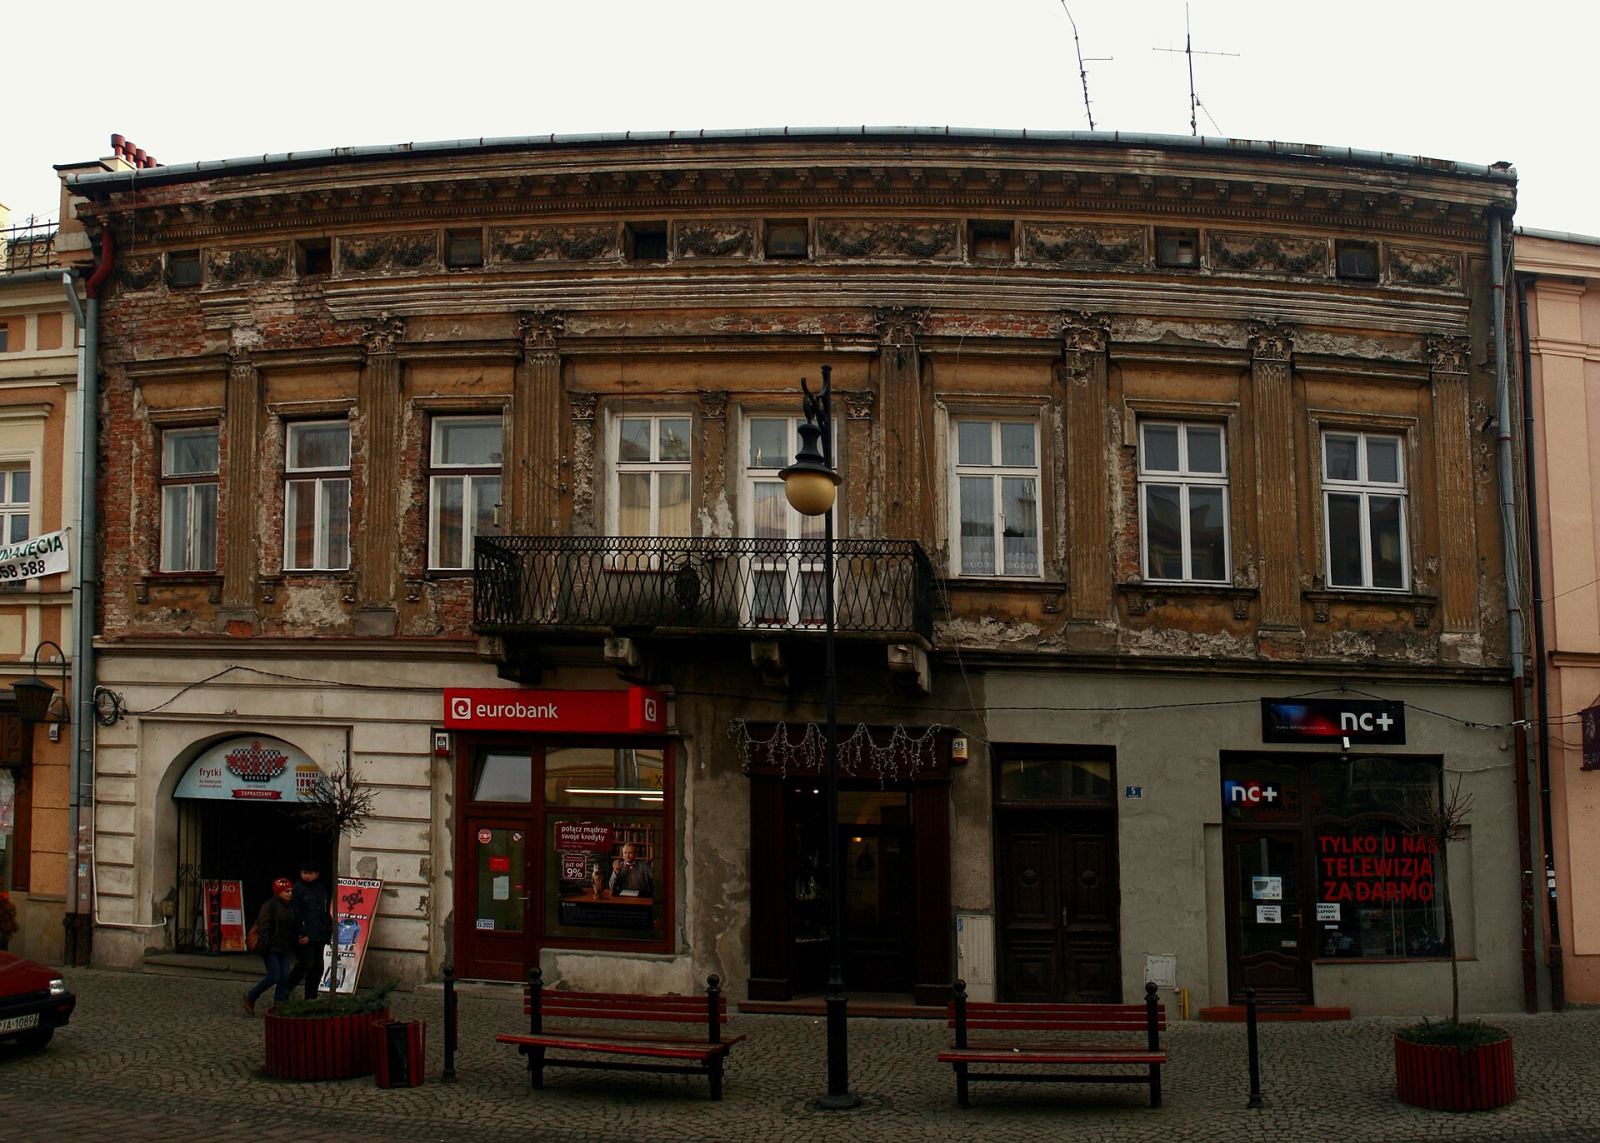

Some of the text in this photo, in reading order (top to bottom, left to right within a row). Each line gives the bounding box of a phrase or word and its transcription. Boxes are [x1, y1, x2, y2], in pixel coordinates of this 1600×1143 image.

[20, 560, 45, 576] 588
[476, 702, 559, 719] eurobank
[1340, 711, 1394, 731] nc+
[199, 767, 222, 778] frytki
[1231, 785, 1278, 802] nc+
[561, 825, 608, 834] połącz mądrze
[561, 833, 605, 842] swoje kredyty
[1319, 833, 1438, 855] TYLKO U NAS
[566, 867, 583, 878] 9%
[1321, 856, 1433, 879] TELEWIZJA
[358, 880, 380, 888] MĘSKA
